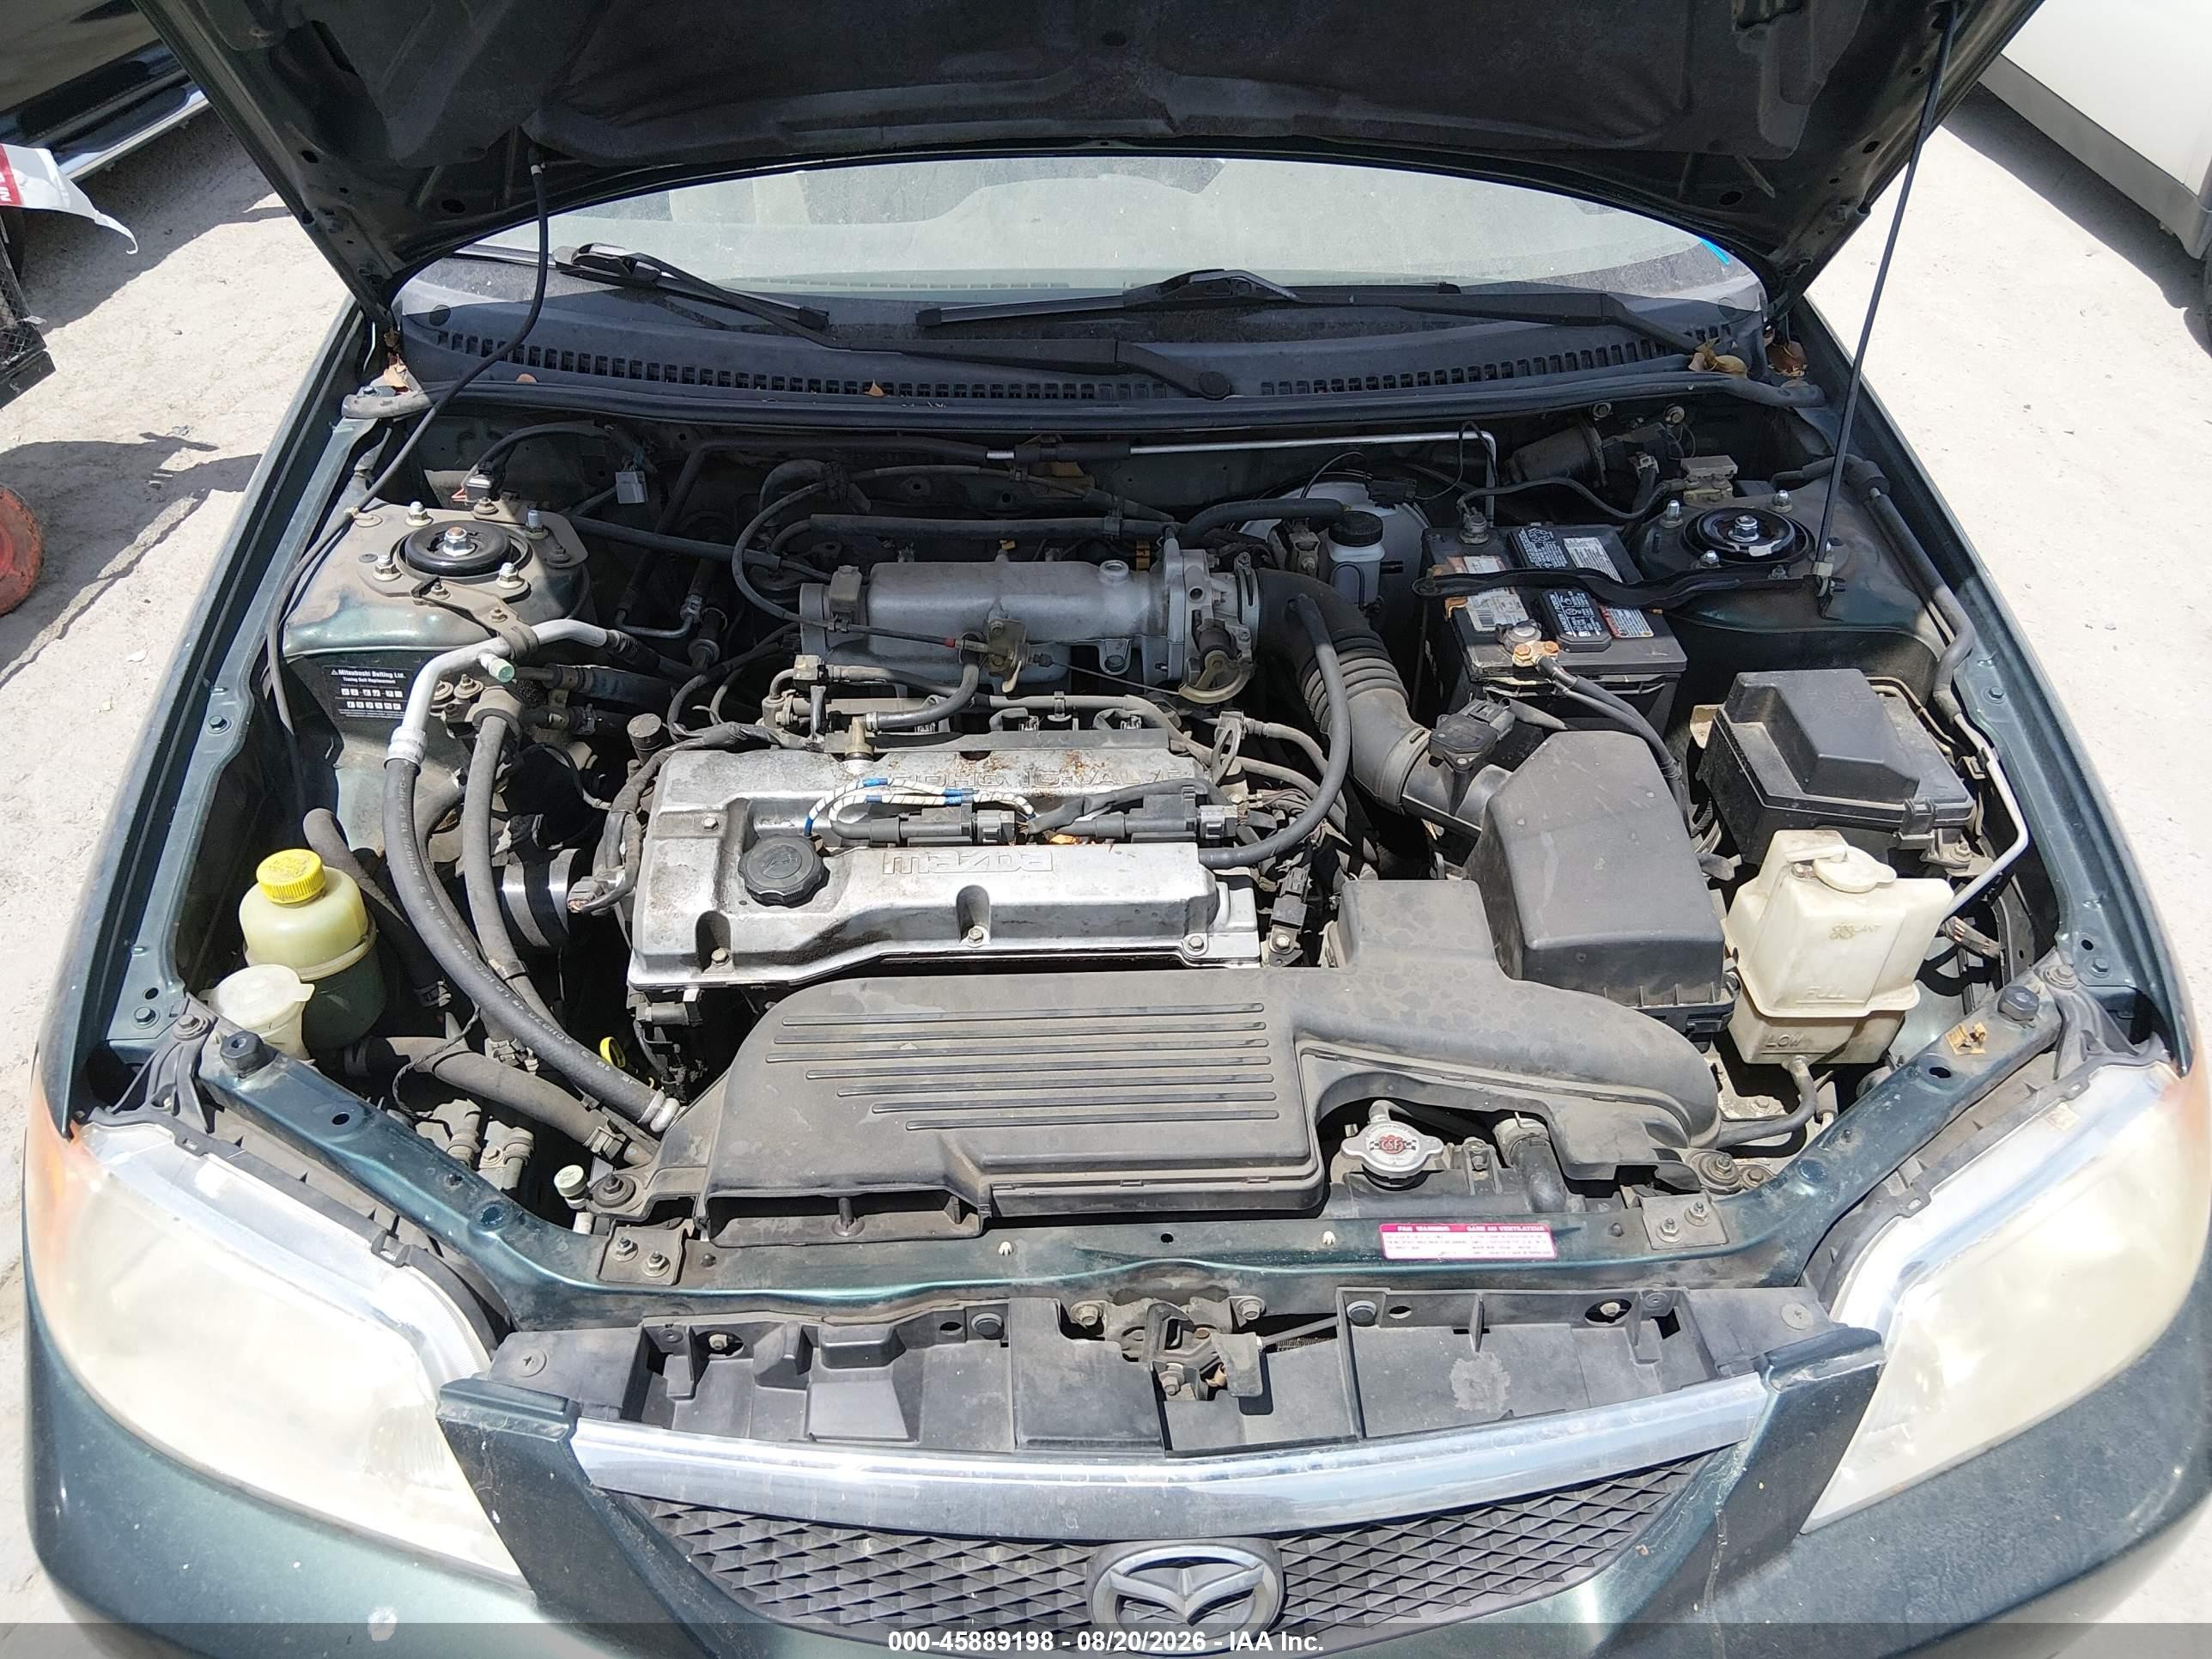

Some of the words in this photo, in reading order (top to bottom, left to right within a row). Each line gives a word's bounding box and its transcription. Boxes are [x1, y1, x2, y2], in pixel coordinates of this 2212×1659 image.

[1807, 985, 1846, 1000] FULL
[1765, 1033, 1804, 1047] LOW
[1381, 1139, 1401, 1151] CSF
